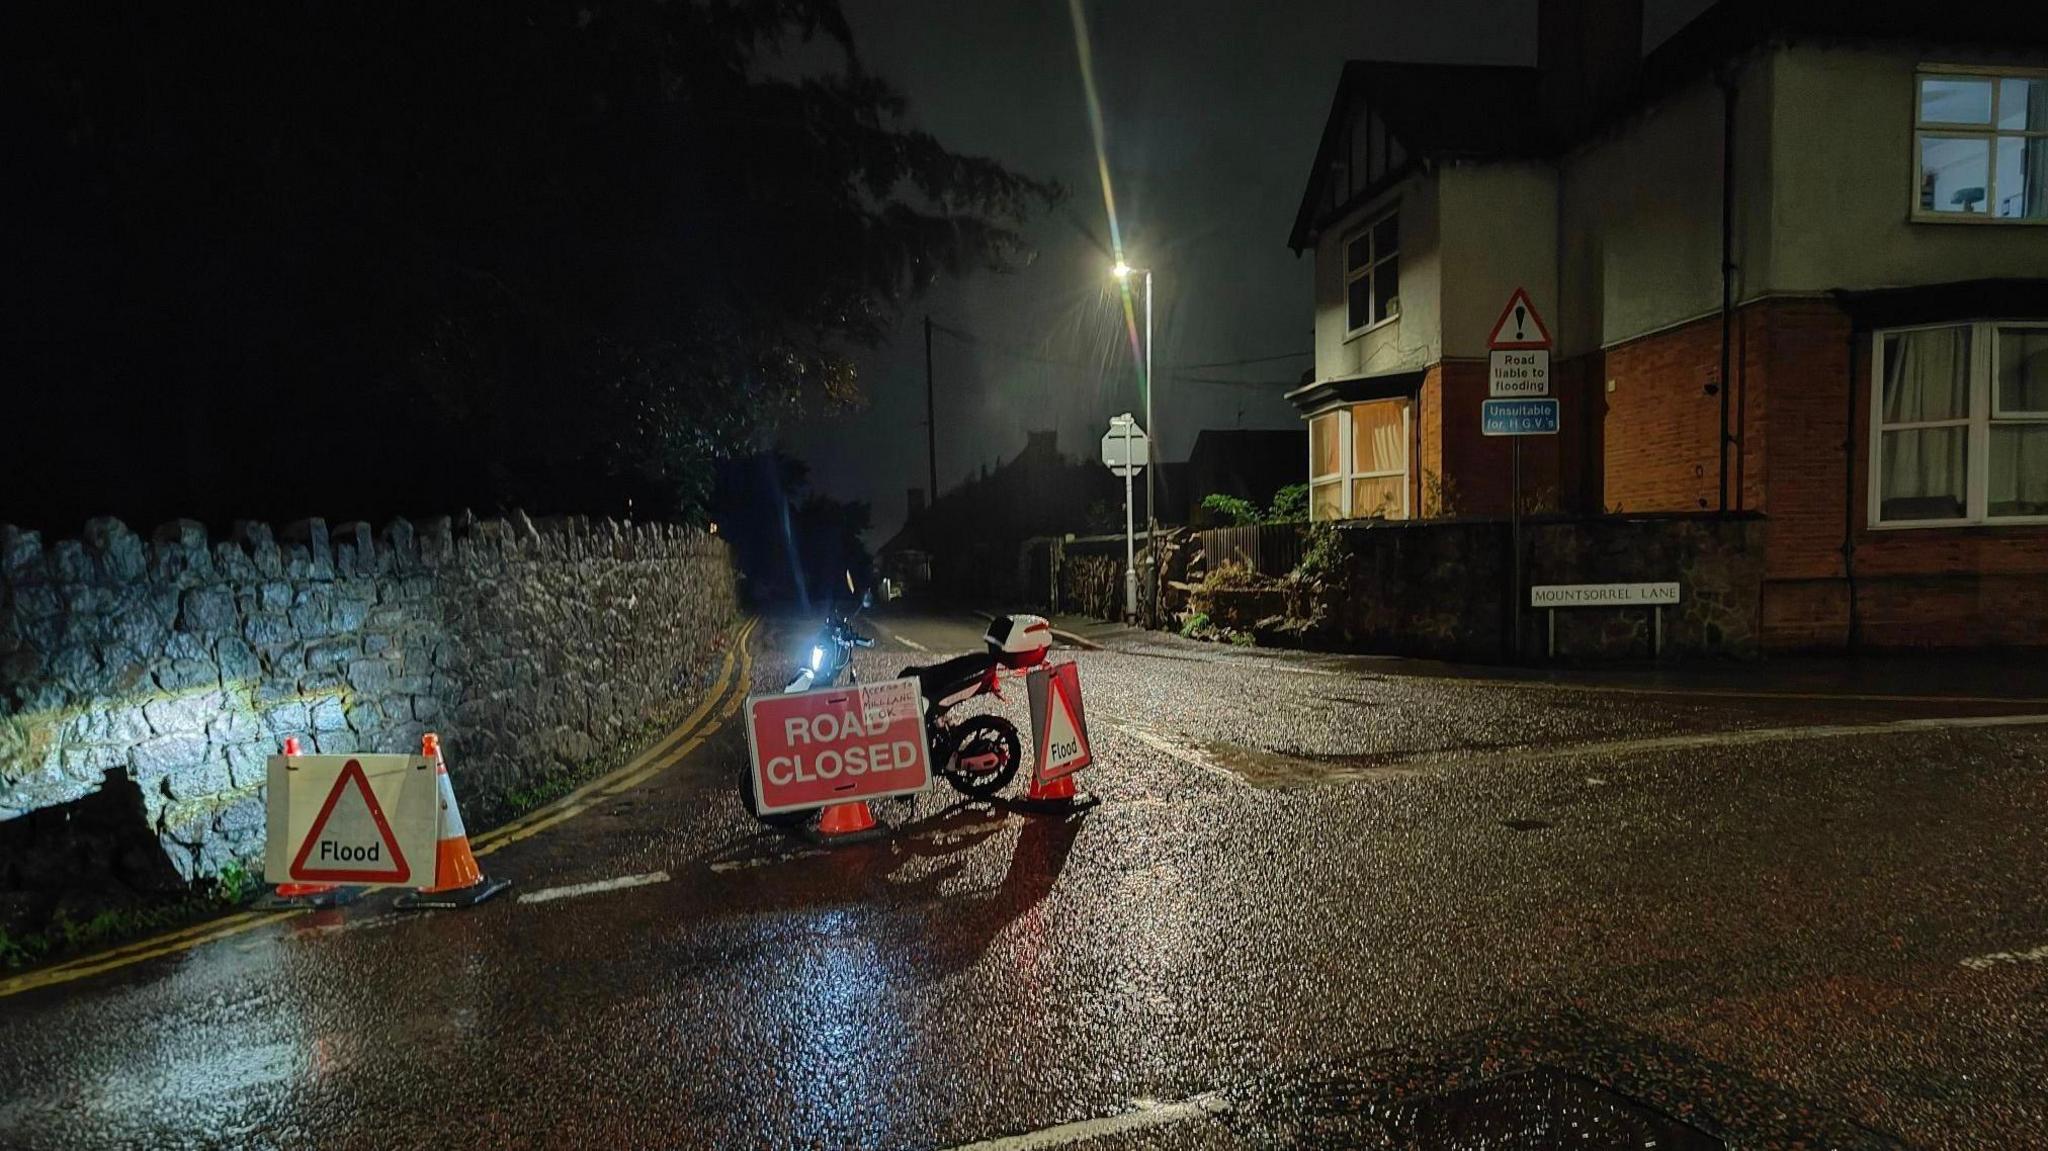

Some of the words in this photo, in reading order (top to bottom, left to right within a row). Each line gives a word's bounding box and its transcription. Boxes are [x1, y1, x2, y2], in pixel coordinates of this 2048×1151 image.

[1504, 354, 1535, 365] Road
[1495, 368, 1528, 378] liable
[1533, 368, 1544, 378] to
[1496, 381, 1544, 392] flooding
[1490, 405, 1551, 416] Unsuitable
[1487, 418, 1503, 430] for
[1535, 589, 1631, 601] MOUNTSORREL
[1641, 587, 1676, 599] LANE
[785, 707, 890, 747] ROAD
[1051, 737, 1077, 762] Flood
[767, 740, 917, 786] CLOSED
[321, 841, 379, 861] Flood
